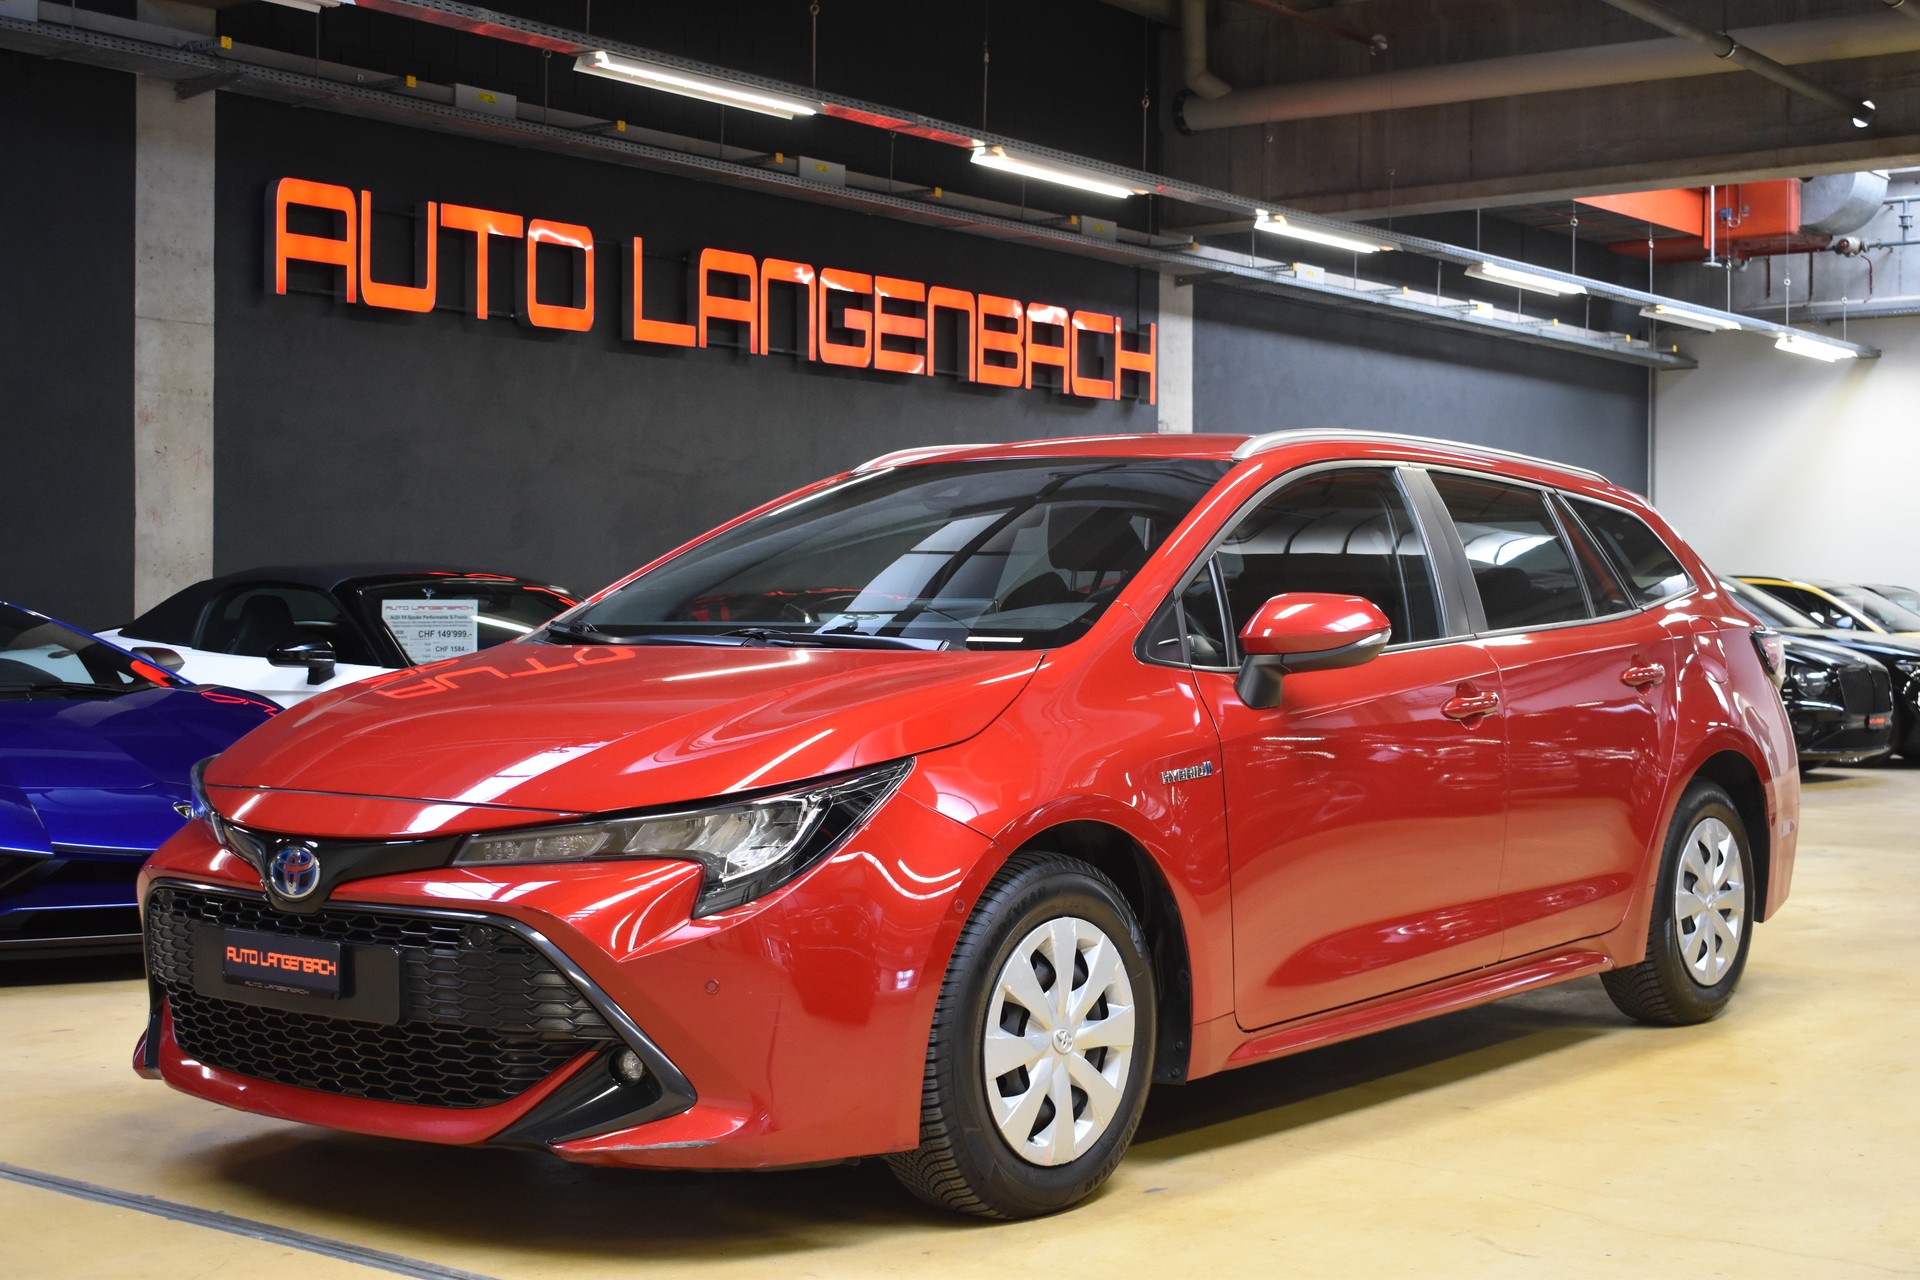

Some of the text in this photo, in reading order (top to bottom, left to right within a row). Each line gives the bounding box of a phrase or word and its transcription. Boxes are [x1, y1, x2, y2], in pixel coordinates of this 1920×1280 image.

[274, 177, 1157, 405] AUTO LANGENBACH
[418, 630, 436, 638] CHF
[1161, 763, 1207, 785] HYBRID
[226, 946, 337, 977] AUTO LANGENBACH
